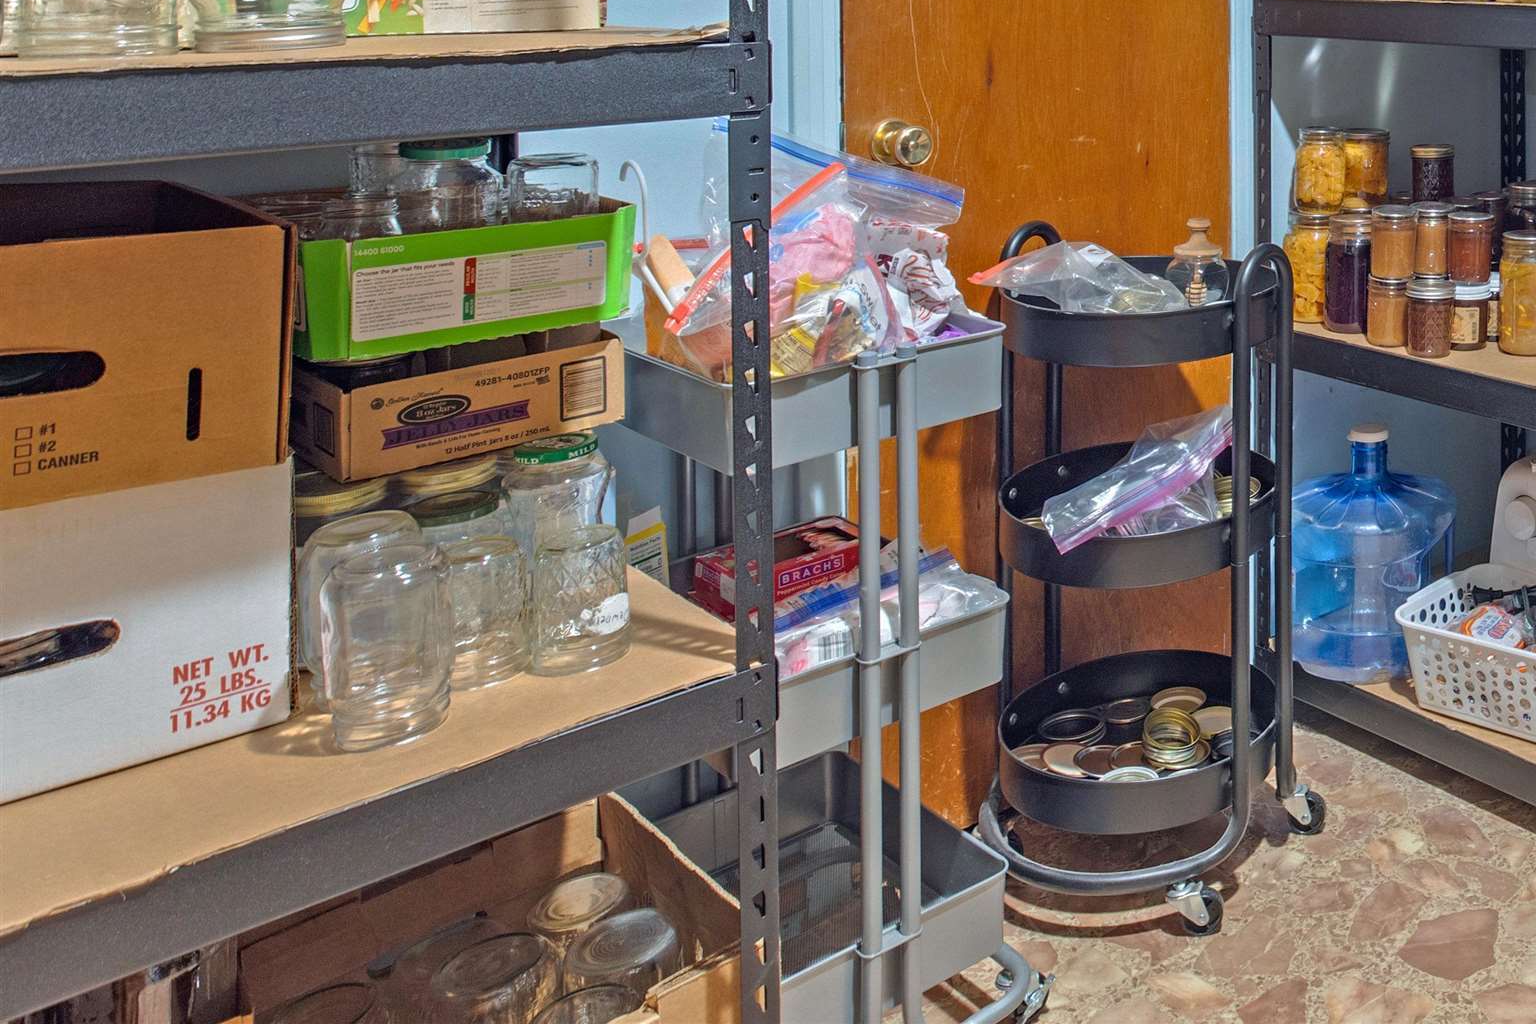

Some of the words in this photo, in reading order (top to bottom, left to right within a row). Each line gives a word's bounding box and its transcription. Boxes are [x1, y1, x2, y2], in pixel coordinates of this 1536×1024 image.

[436, 404, 456, 416] Jars
[39, 423, 56, 436] #1
[387, 421, 457, 445] JELLY
[465, 406, 525, 427] JARS
[39, 440, 57, 453] #2
[453, 442, 470, 453] Half
[471, 438, 487, 449] Pint
[488, 436, 503, 447] Jars
[525, 427, 539, 437] 250
[567, 443, 596, 459] MILD
[38, 450, 99, 471] CANNER
[780, 558, 843, 585] BRACHS
[173, 657, 214, 685] NET
[229, 643, 269, 669] WT.
[180, 682, 207, 705] 25
[220, 668, 263, 694] LBS.
[170, 699, 231, 733] 11.34
[241, 689, 271, 713] KG
